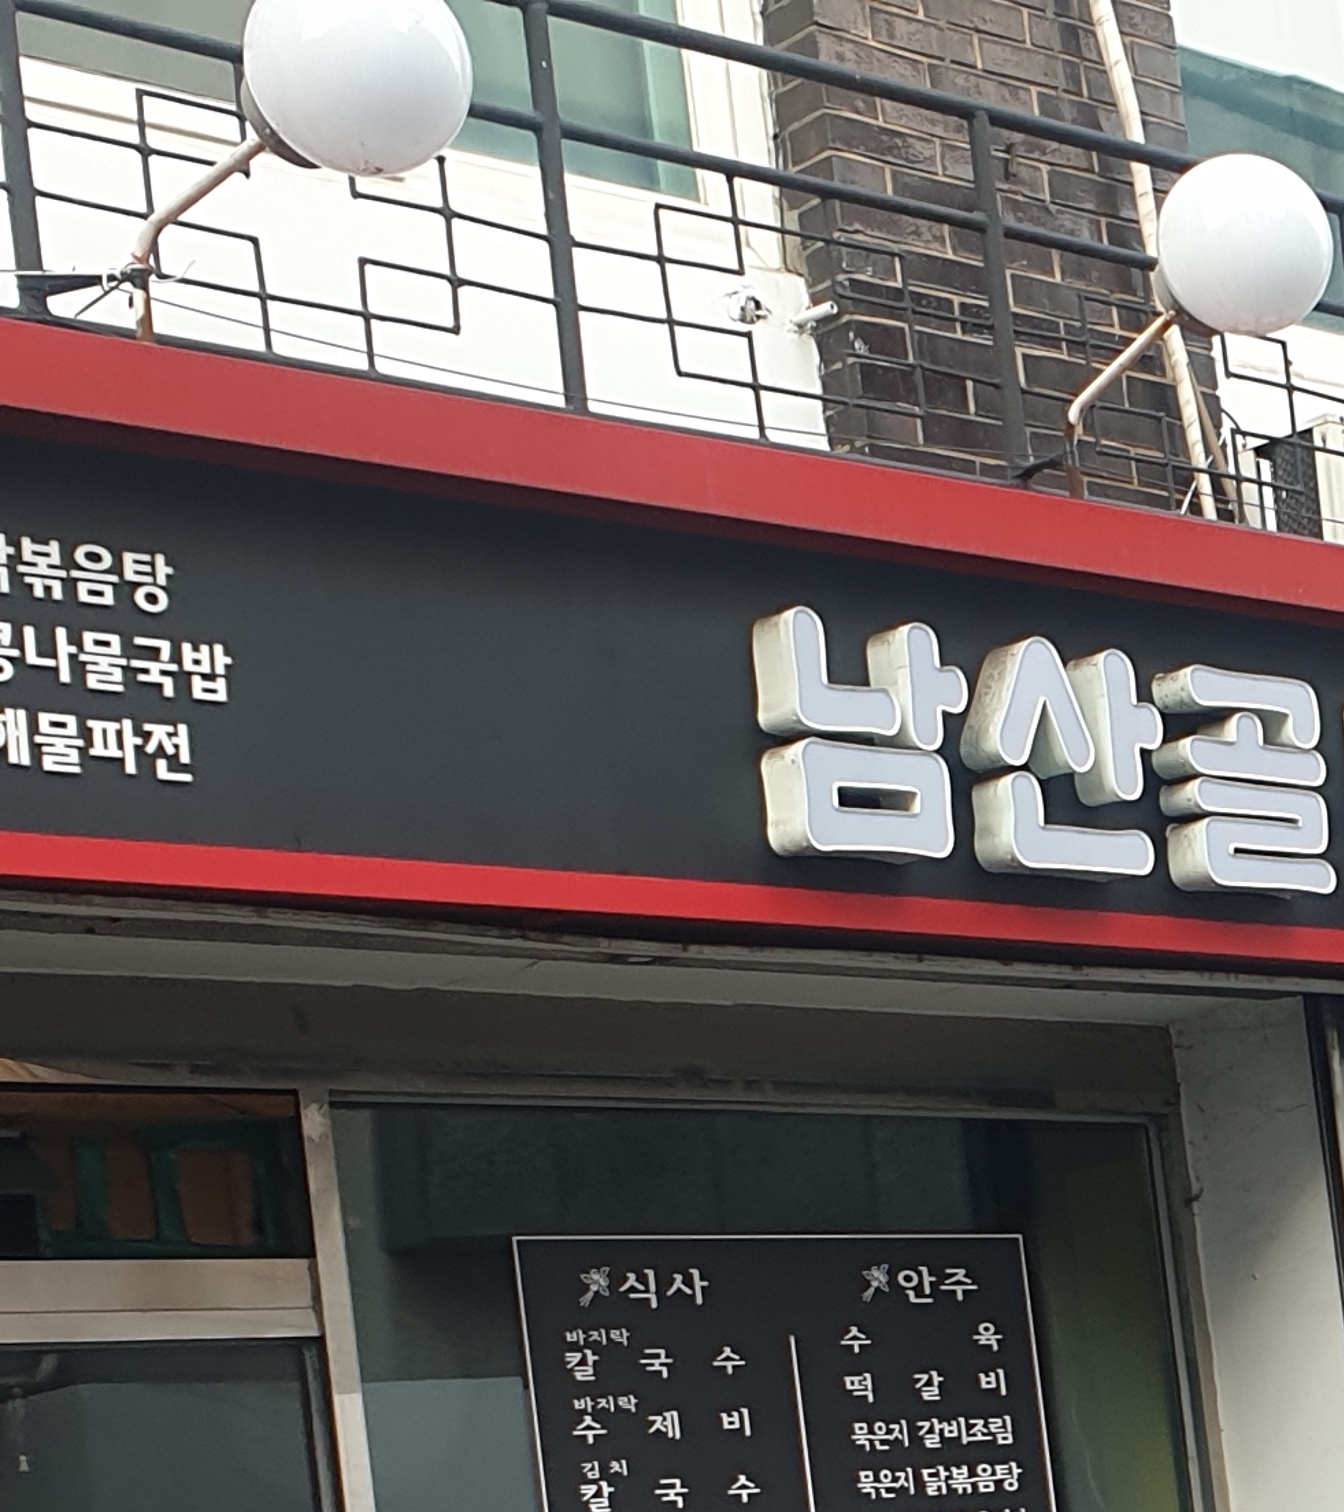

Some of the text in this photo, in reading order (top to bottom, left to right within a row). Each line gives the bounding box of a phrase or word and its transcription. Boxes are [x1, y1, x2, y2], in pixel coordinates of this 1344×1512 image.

[753, 604, 1336, 896] 남산골
[618, 1268, 709, 1309] 식사
[898, 1266, 980, 1302] 안주
[565, 1328, 630, 1347] 바지락
[573, 1394, 639, 1414] 바지락
[851, 1416, 1015, 1452] 묵은지 갈비조림
[857, 1462, 1023, 1499] 묵은지 닭볶음탕
